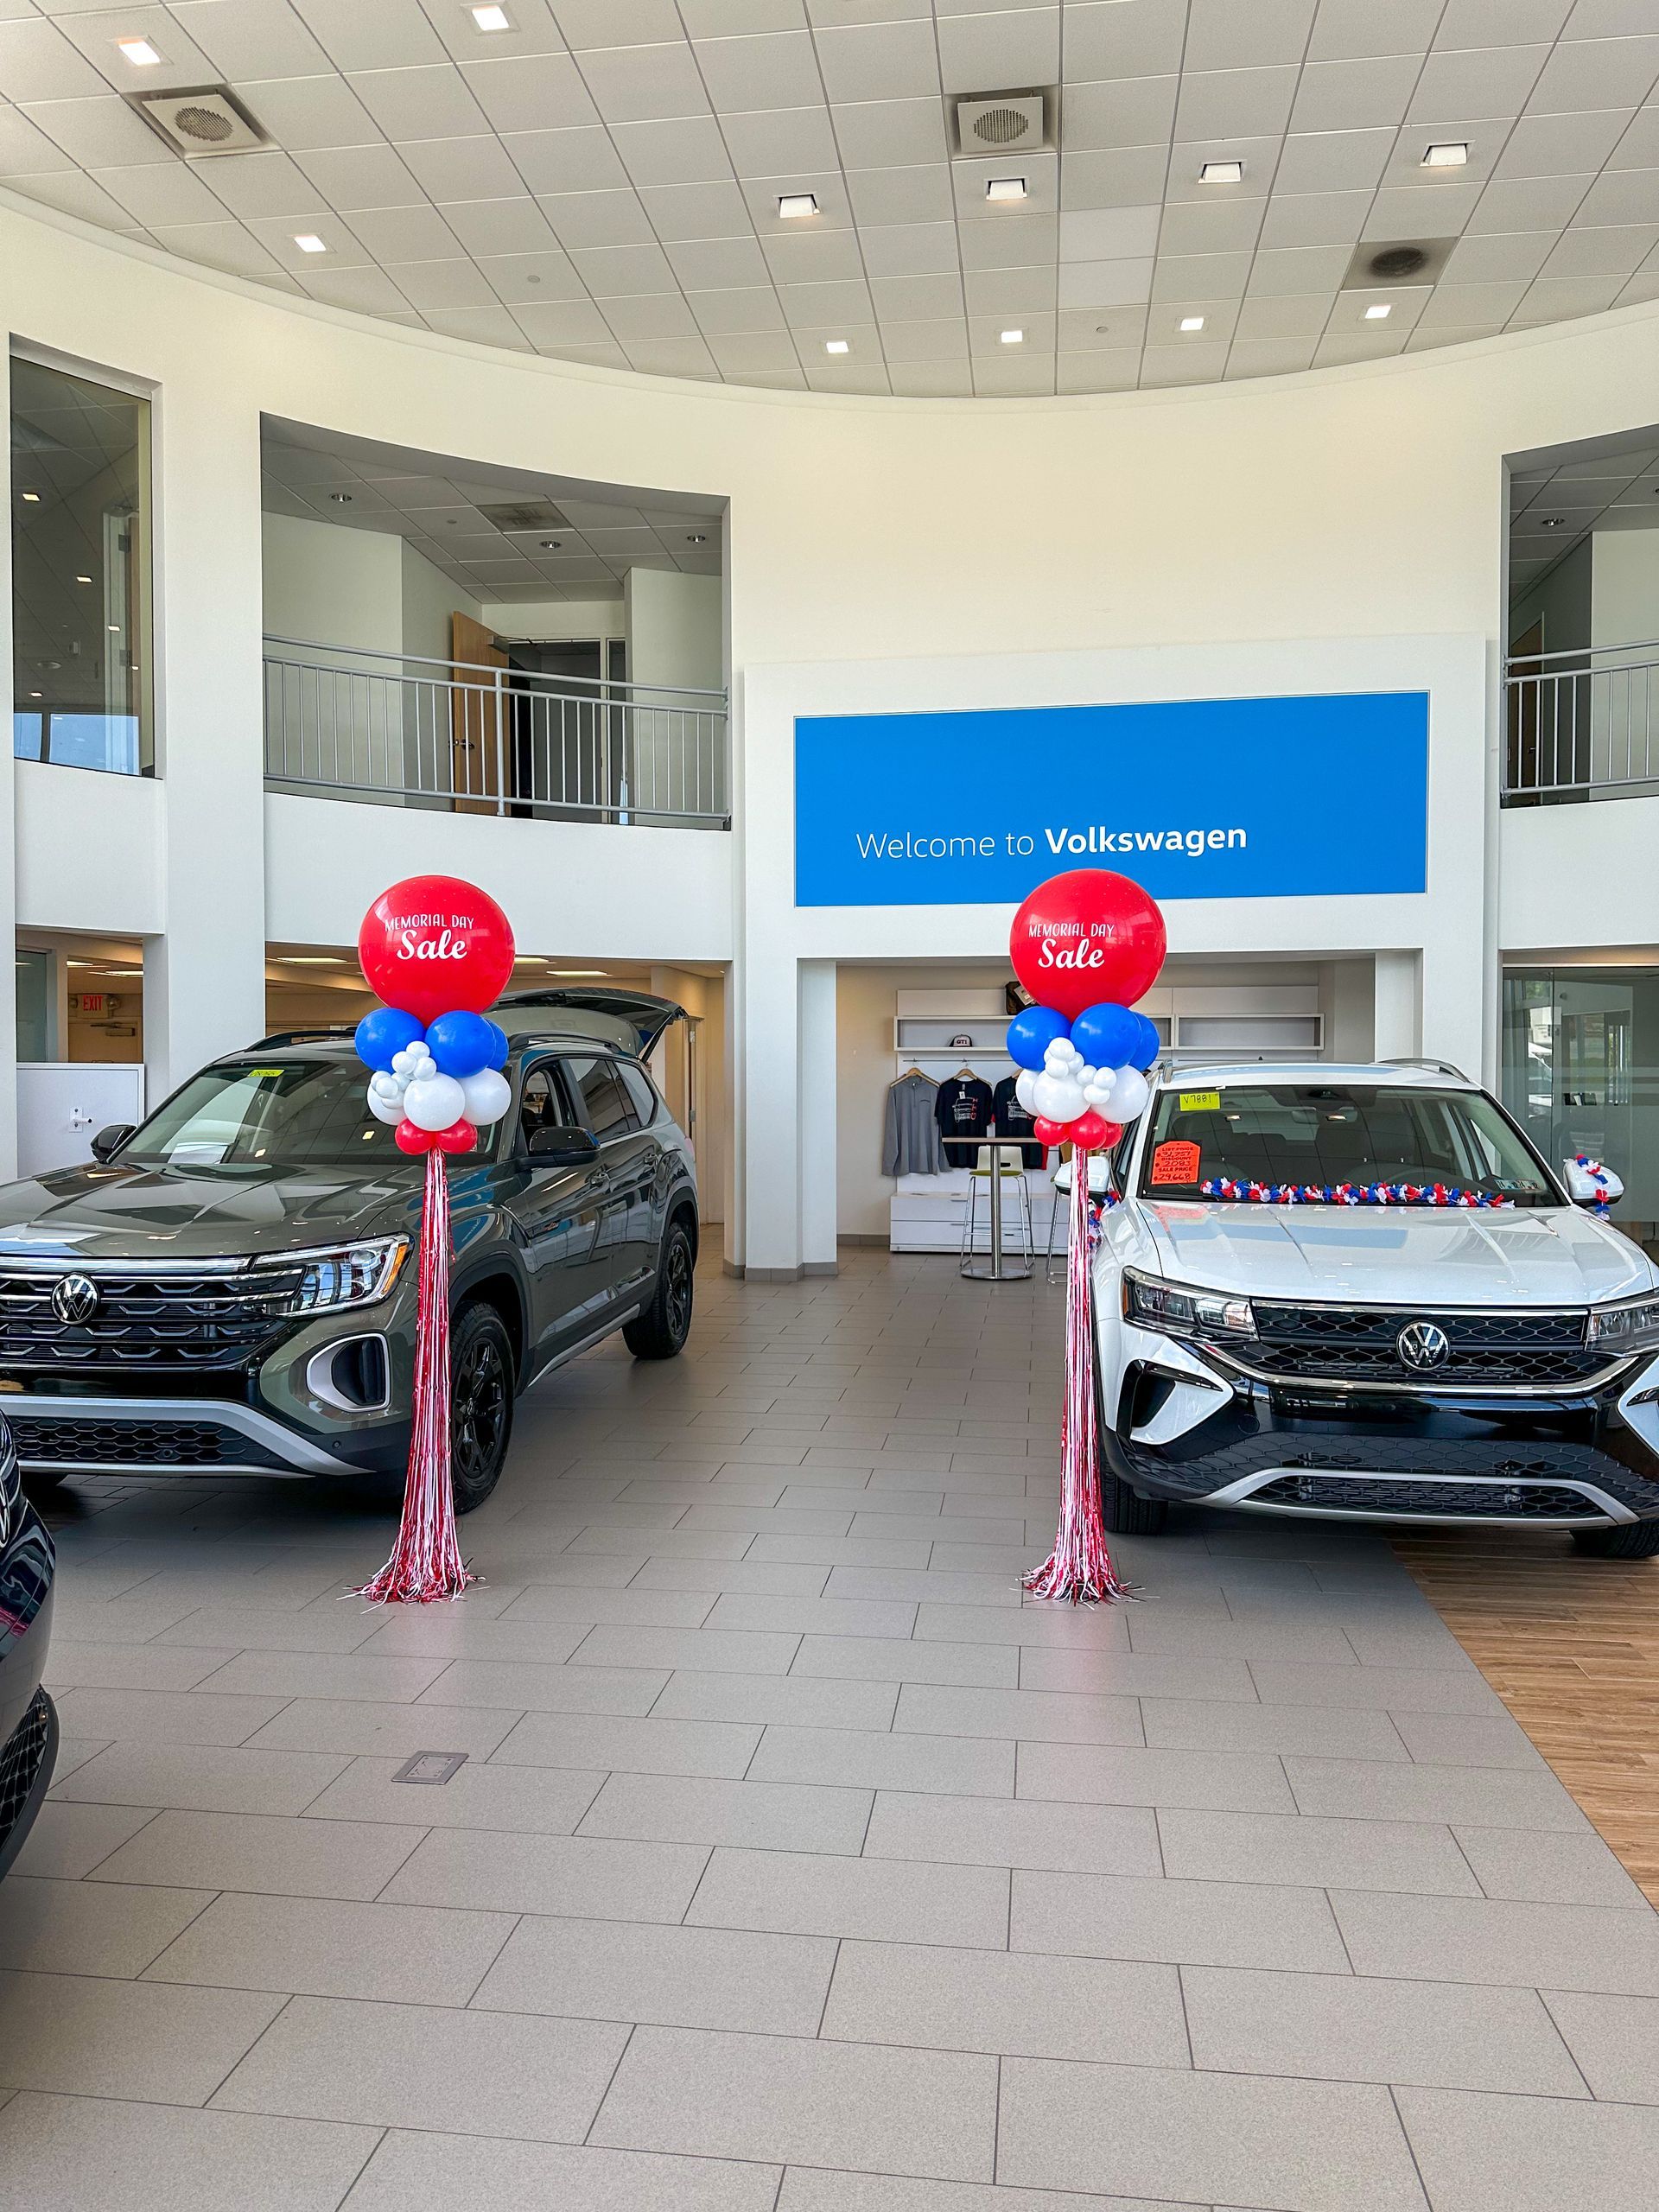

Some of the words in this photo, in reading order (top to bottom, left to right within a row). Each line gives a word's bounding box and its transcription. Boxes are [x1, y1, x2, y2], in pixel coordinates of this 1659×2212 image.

[856, 832, 996, 859] Welcome
[1005, 832, 1034, 856] to
[1045, 826, 1248, 857] Volkswagen
[385, 913, 448, 932] MEMORIAL
[451, 914, 474, 930] DAY
[1028, 922, 1086, 938] MEMORIAL
[1090, 922, 1115, 938] DAY
[397, 929, 467, 960] Sale
[1037, 938, 1105, 969] Sale
[82, 995, 103, 1011] EXIT
